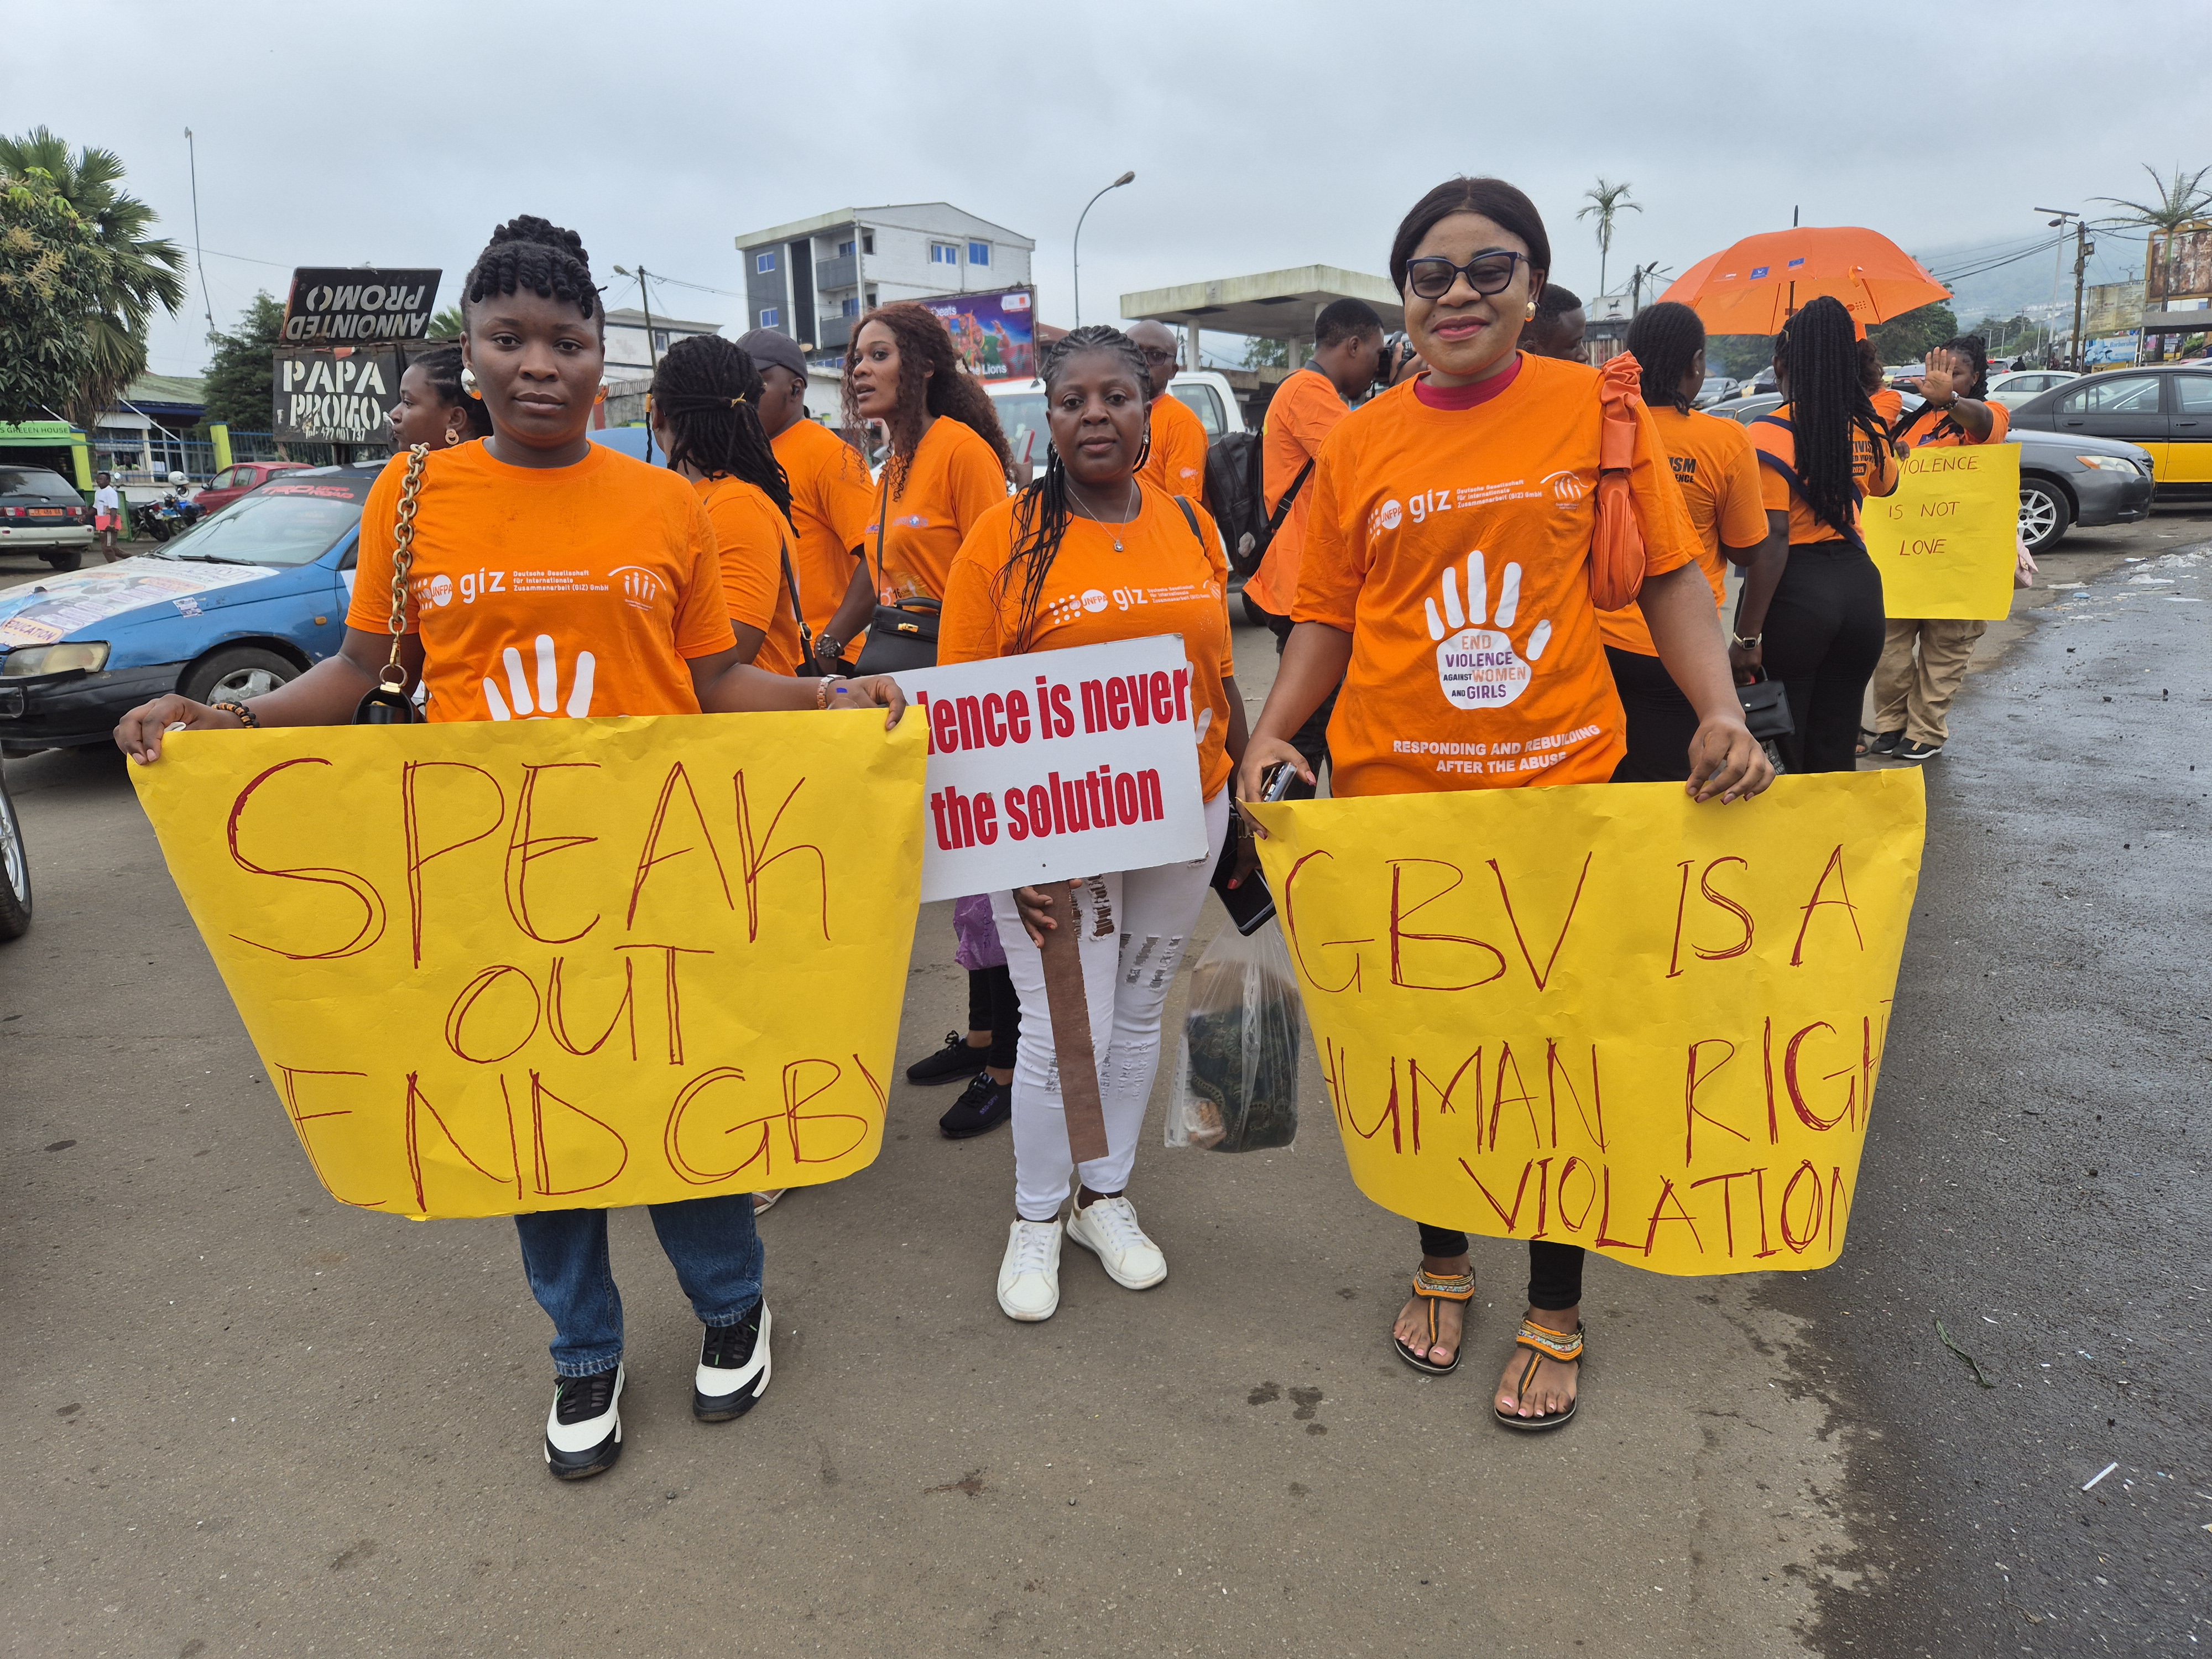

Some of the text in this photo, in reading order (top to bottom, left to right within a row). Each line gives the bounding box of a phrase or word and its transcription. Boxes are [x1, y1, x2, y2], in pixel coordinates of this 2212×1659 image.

[306, 285, 425, 312] PROMO
[286, 312, 428, 341] ANNOINTED
[283, 361, 387, 394] PAPA
[981, 362, 1008, 375] Lions
[290, 394, 381, 431] PROMO
[1668, 457, 1697, 473] ISM
[1456, 479, 1524, 494] Deutsche Gesellschaft
[1468, 488, 1511, 500] Internationale
[1409, 488, 1452, 523] giz
[1457, 494, 1507, 509] Zusammenarbeit
[1889, 502, 1960, 520] IS NOT
[1900, 539, 1947, 556] LOVE
[460, 567, 506, 604] giz
[893, 587, 902, 599] 16
[1112, 586, 1149, 611] giz
[7, 620, 57, 641] EDUCATION
[1462, 634, 1491, 650] END
[1445, 651, 1512, 668] VIOLENCE
[1472, 666, 1526, 683] WOMEN
[1467, 684, 1506, 700] GIRLS
[916, 667, 1189, 755] lence is never
[1393, 724, 1601, 756] RESPONDING AND REBUILDING
[1436, 752, 1567, 774] AFTER THE ABUSE
[930, 764, 1165, 851] the solution
[227, 756, 831, 969] SPEAK
[1285, 843, 1865, 994] GBV IS A
[445, 942, 715, 1066] OUT
[1685, 999, 1893, 1168] RIGH
[274, 1060, 629, 1213] END
[1459, 1156, 1849, 1259] VIOLATION
